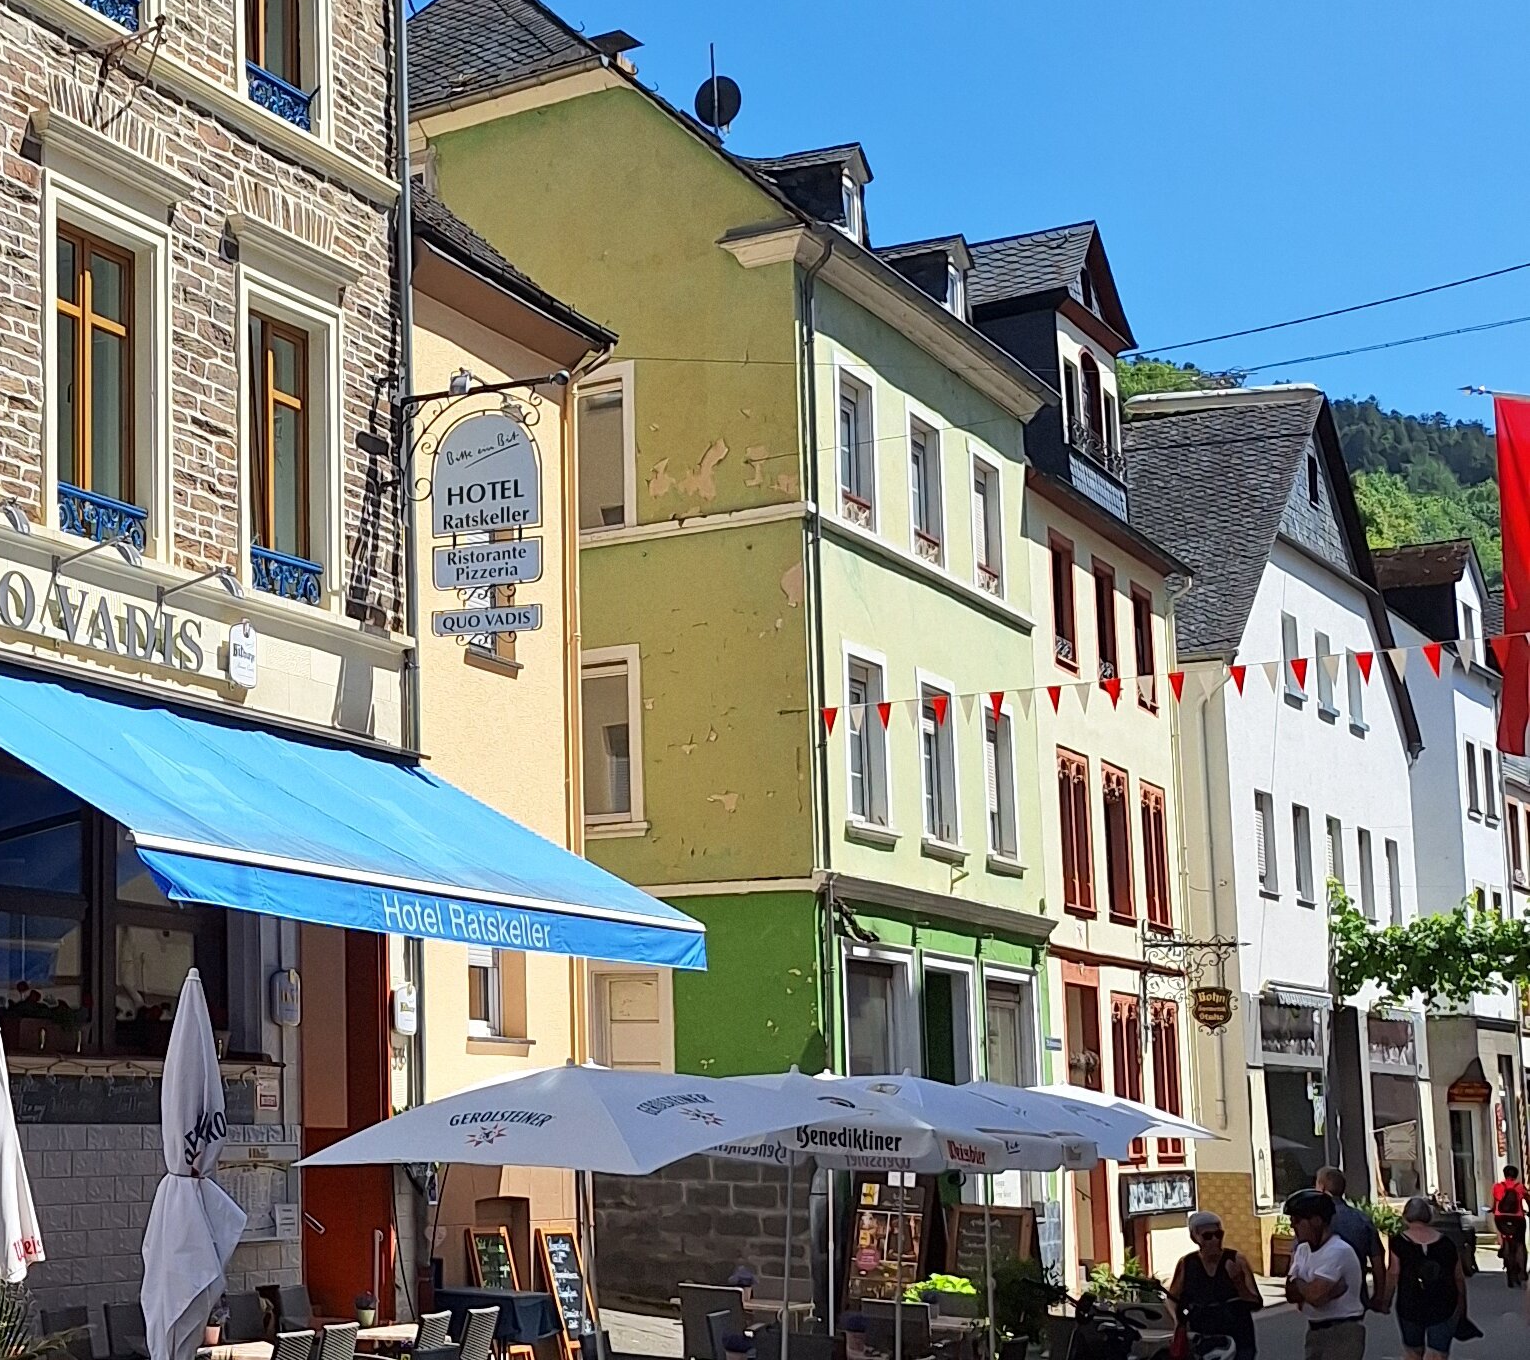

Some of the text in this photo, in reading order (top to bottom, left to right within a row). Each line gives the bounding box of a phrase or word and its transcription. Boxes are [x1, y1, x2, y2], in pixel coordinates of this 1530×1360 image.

[447, 478, 525, 506] HOTEL
[442, 506, 530, 530] Ratskeller
[447, 546, 527, 566] Ristorante
[455, 564, 519, 582] Pizzeria
[55, 583, 204, 673] VADIS
[442, 610, 531, 631] QUO VADIS
[381, 892, 551, 949] Hotel Ratskeller
[449, 1109, 553, 1128] GEROLSTEINER
[796, 1125, 903, 1151] Benediktiner
